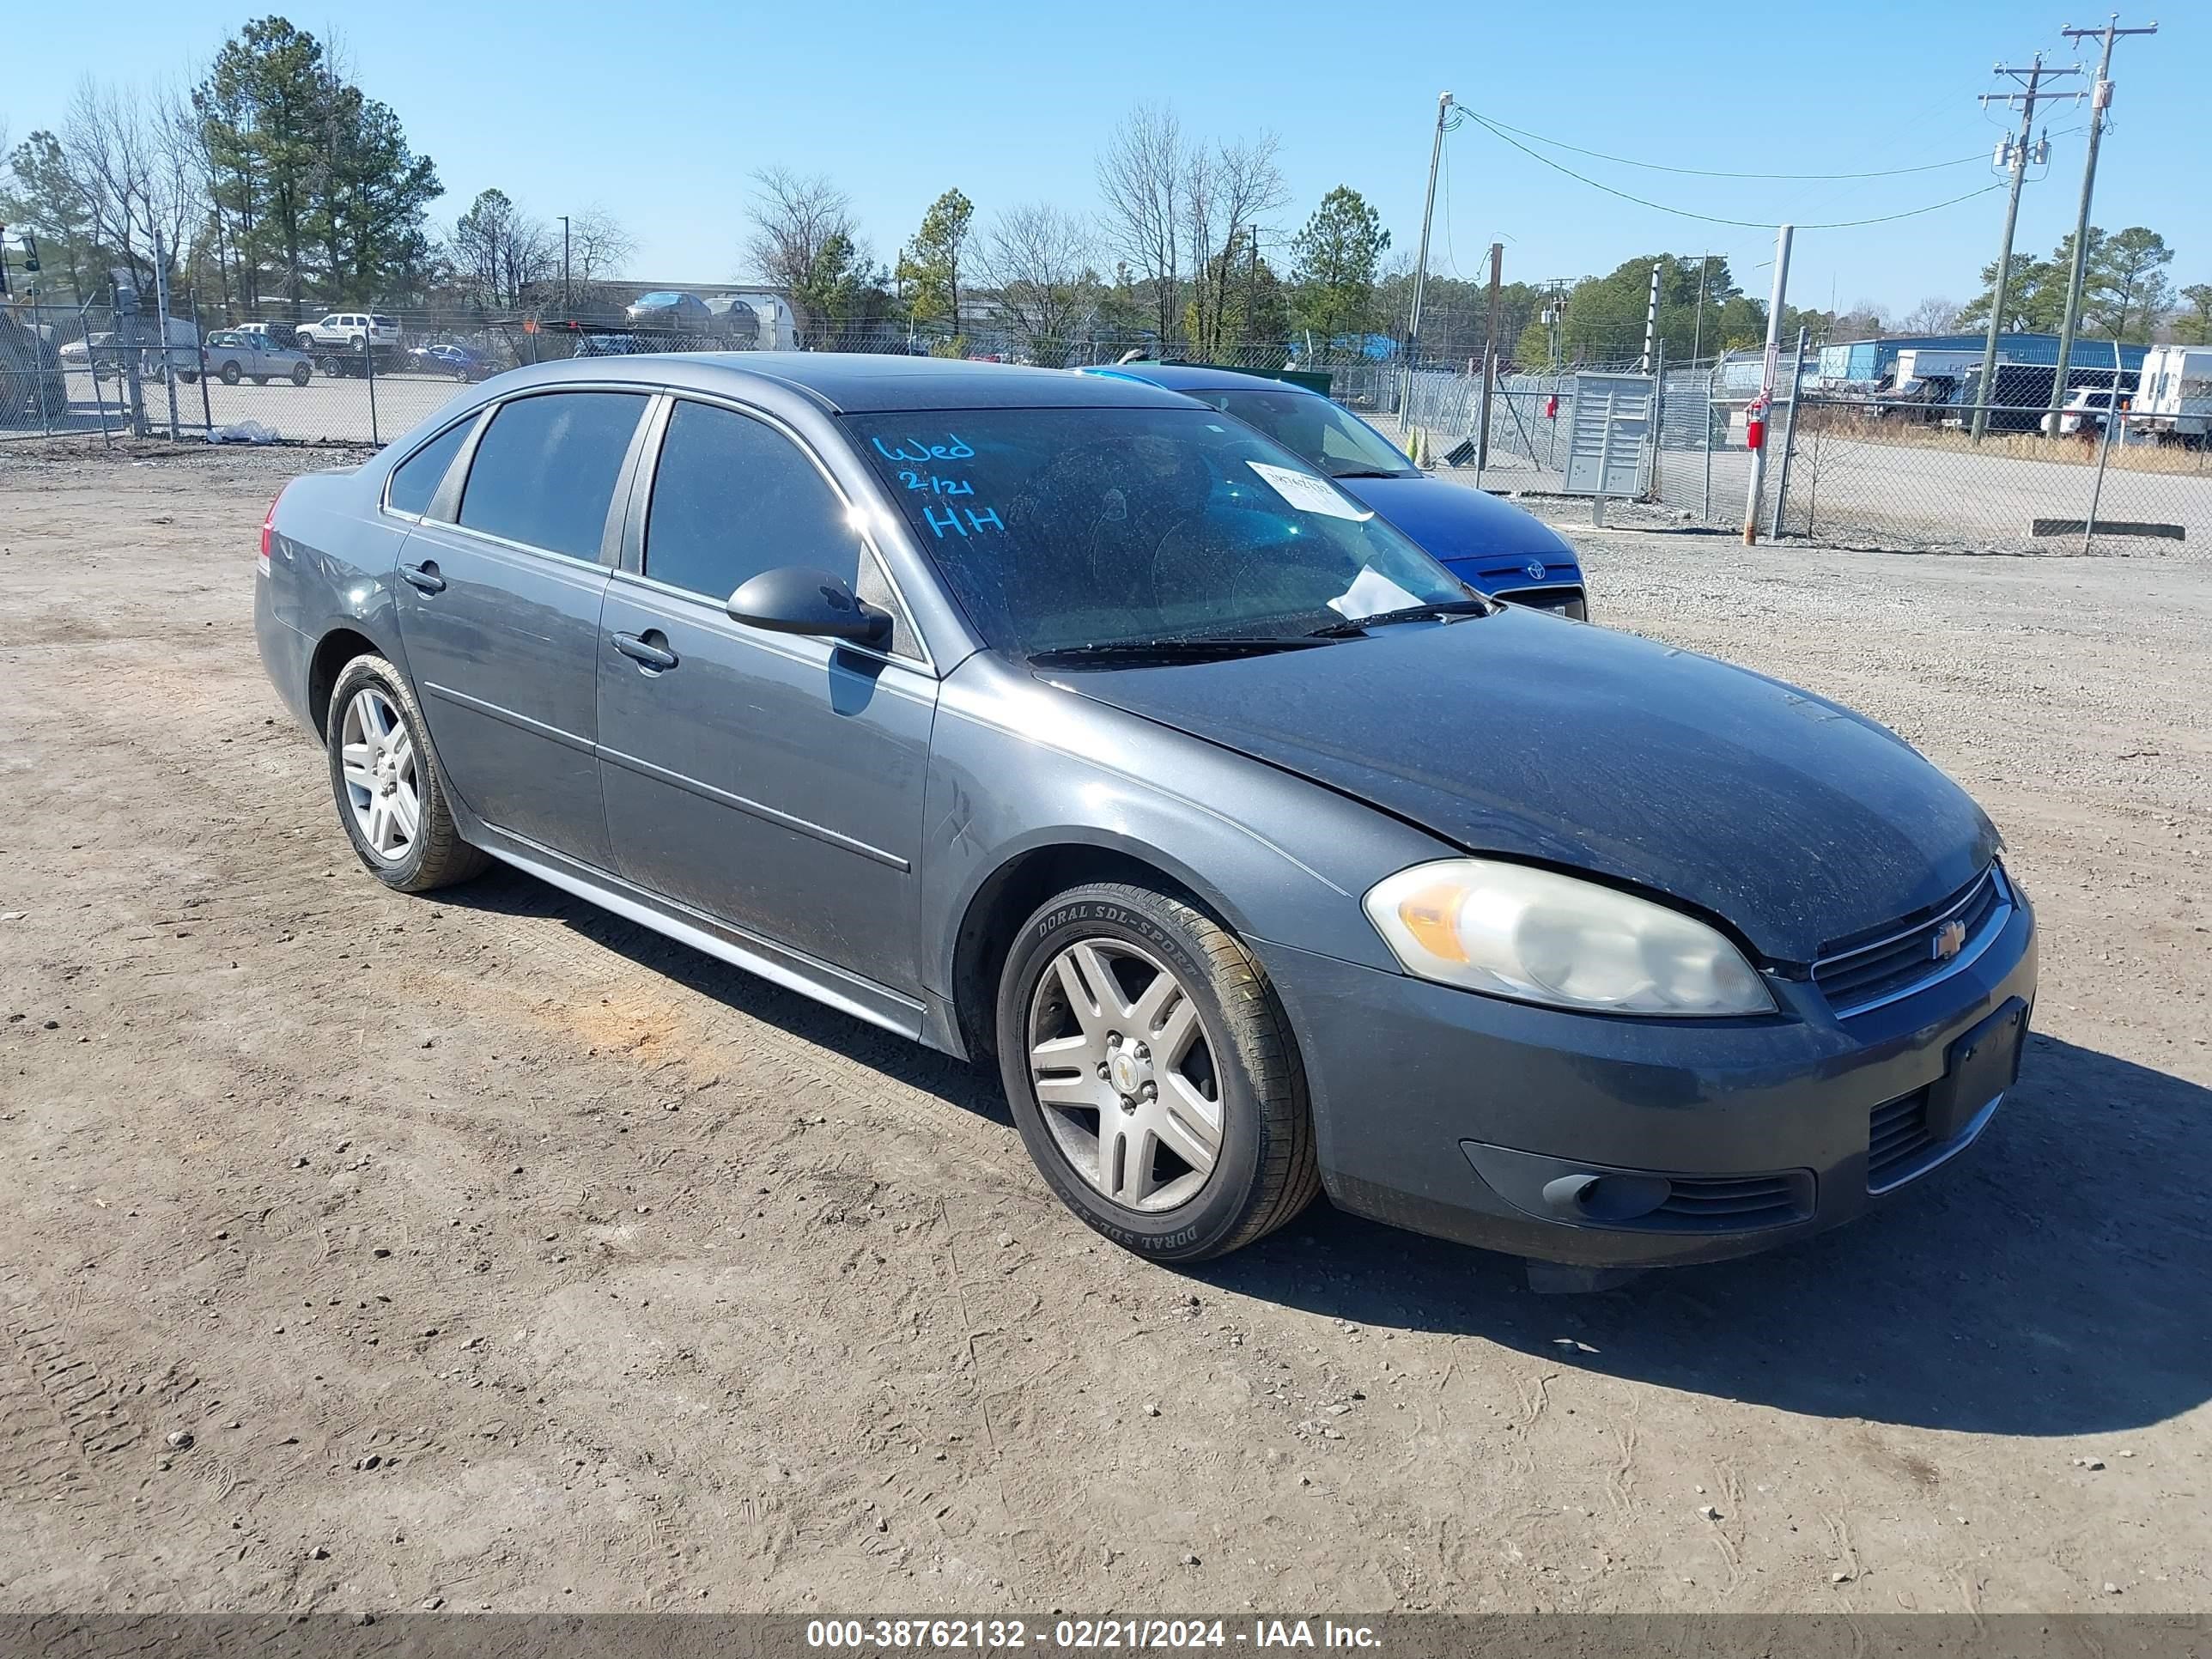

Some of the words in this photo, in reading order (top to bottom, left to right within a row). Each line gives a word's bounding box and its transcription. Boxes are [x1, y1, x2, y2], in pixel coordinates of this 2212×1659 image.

[872, 433, 975, 461] Wed
[1038, 905, 1089, 939] DORAL
[1095, 905, 1198, 977] SDL-SPORT
[1140, 1224, 1199, 1250] DORAL
